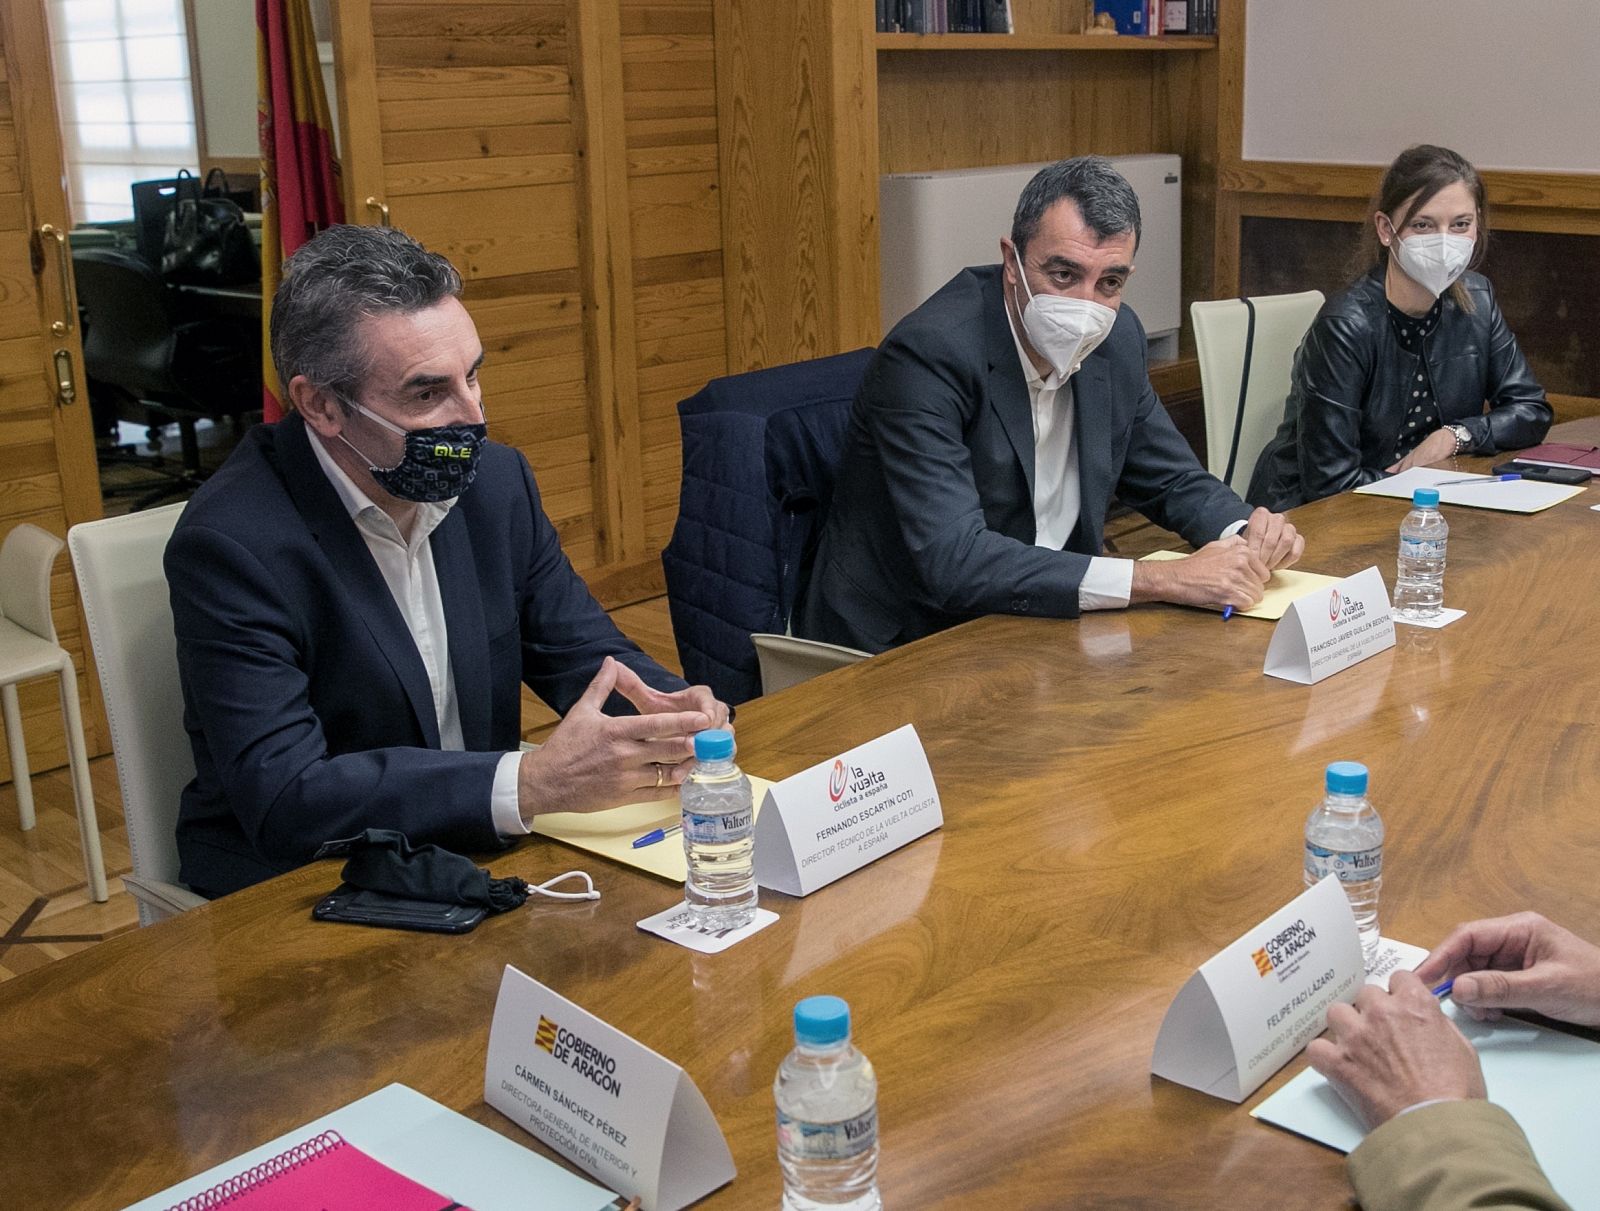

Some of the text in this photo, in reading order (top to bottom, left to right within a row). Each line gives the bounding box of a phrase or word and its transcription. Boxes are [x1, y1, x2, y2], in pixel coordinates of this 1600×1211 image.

[1343, 595, 1351, 605] la
[1310, 637, 1337, 654] FRANCISCO
[1338, 630, 1354, 643] JAVIER
[1372, 614, 1391, 629] BEDOYA
[849, 771, 886, 793] vuelta
[851, 765, 864, 778] la
[816, 788, 914, 842] FERNANDO ESCARTÍN COTI
[834, 797, 858, 812] ciclista
[865, 783, 889, 799] españa
[801, 797, 936, 868] DIRECTOR TÉCNICO DE LA VUELTA CICLISTA
[863, 831, 889, 850] ESPAÑA
[1265, 919, 1306, 954] GOBIERNO
[1271, 952, 1284, 968] DE
[1284, 926, 1317, 962] ARAGON
[1266, 1004, 1292, 1030] FELIPE
[1291, 992, 1308, 1013] FACI
[554, 1044, 621, 1098] DE ARAGON
[557, 1028, 616, 1074] GOBIERNO
[514, 1064, 628, 1148] CÁRMEN SÁNCHEZ PÉREZ
[501, 1079, 638, 1178] DIRECTORA GENERAL DE INTERIOR Y
[529, 1115, 599, 1169] PROTECCIÓN CIVIL
